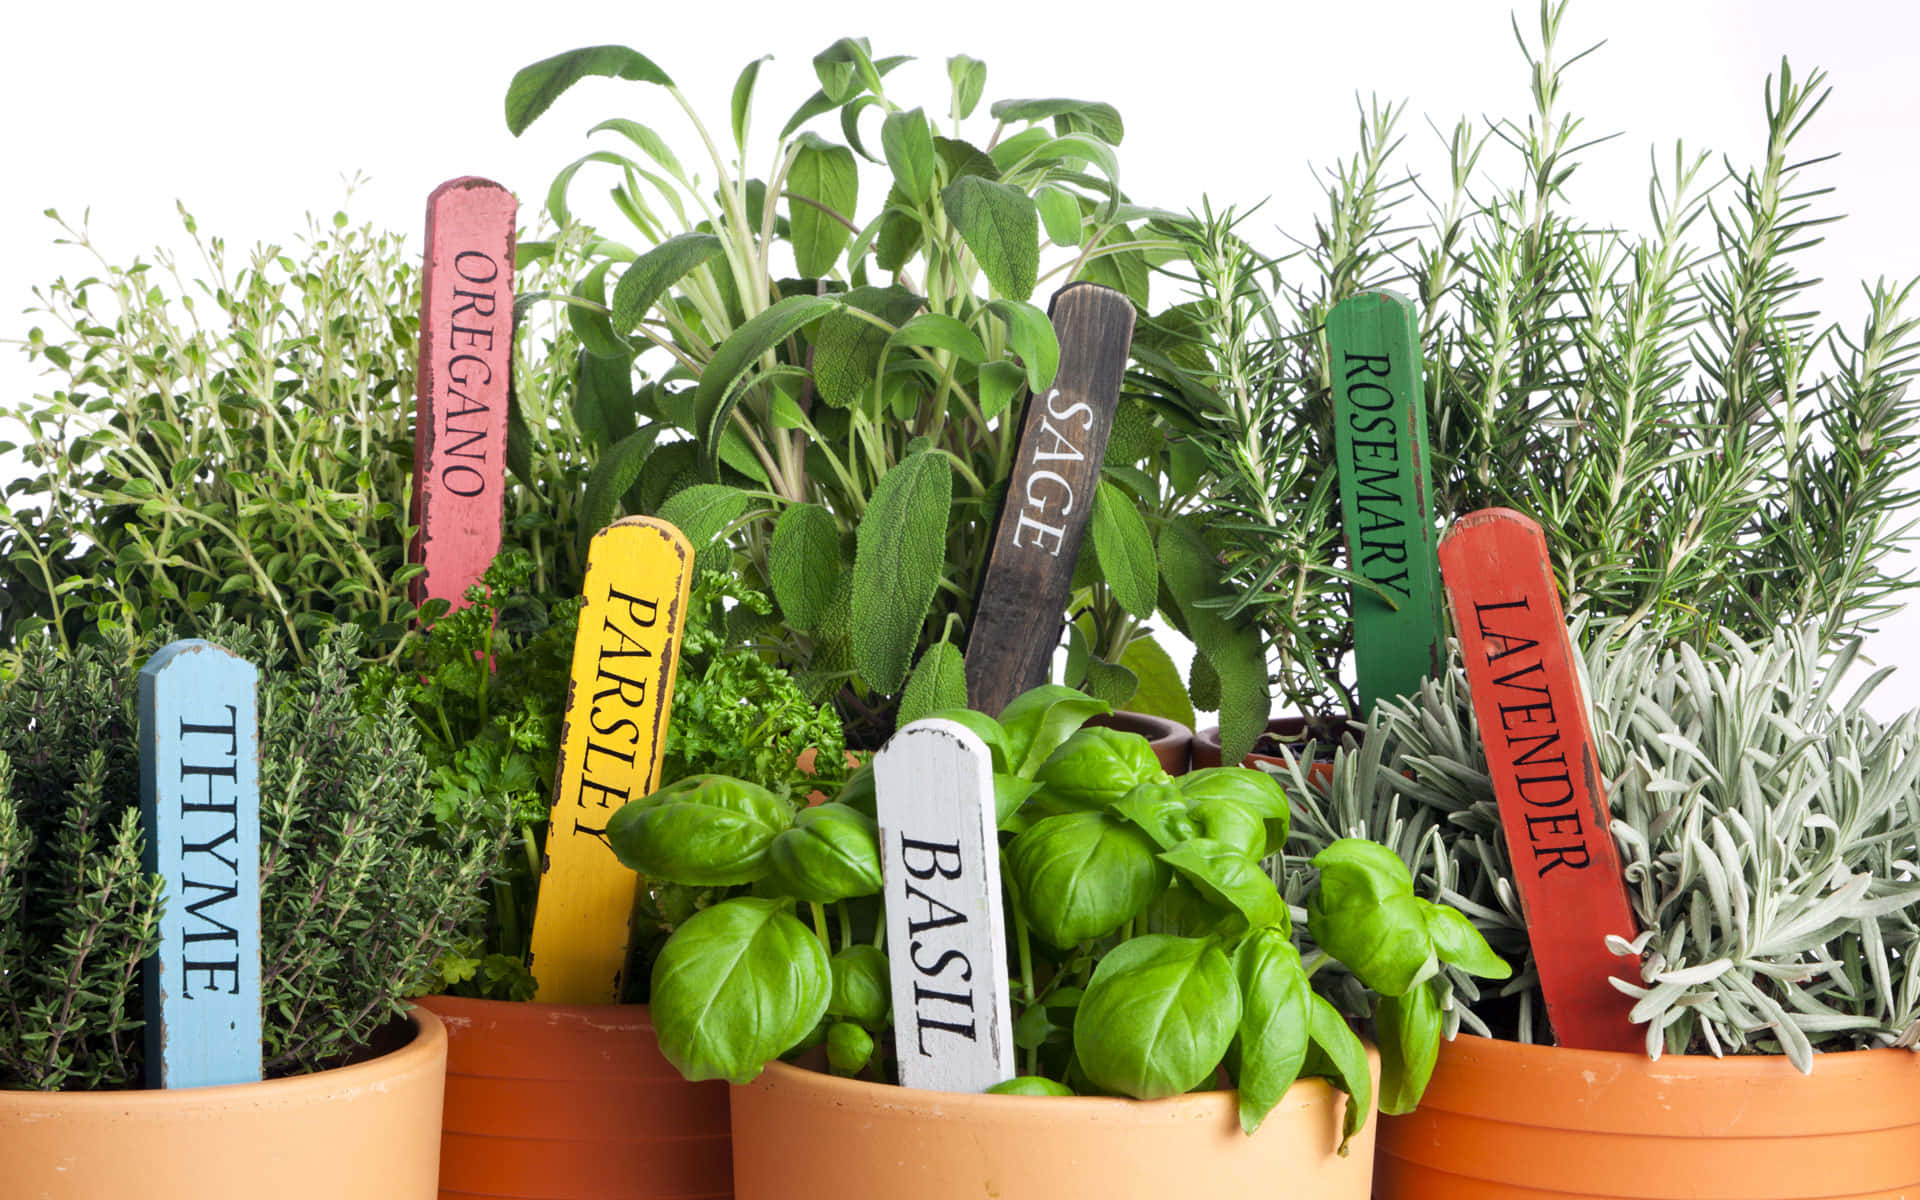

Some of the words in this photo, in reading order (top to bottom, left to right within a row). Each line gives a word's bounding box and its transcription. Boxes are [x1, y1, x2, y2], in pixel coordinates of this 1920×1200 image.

[441, 250, 498, 498] OREGANO
[1012, 388, 1094, 557] SAGE
[1343, 350, 1411, 598] ROSEMARY
[179, 704, 240, 1000] THYME
[1473, 595, 1591, 879] LAVENDER
[900, 830, 977, 1058] BASIL
